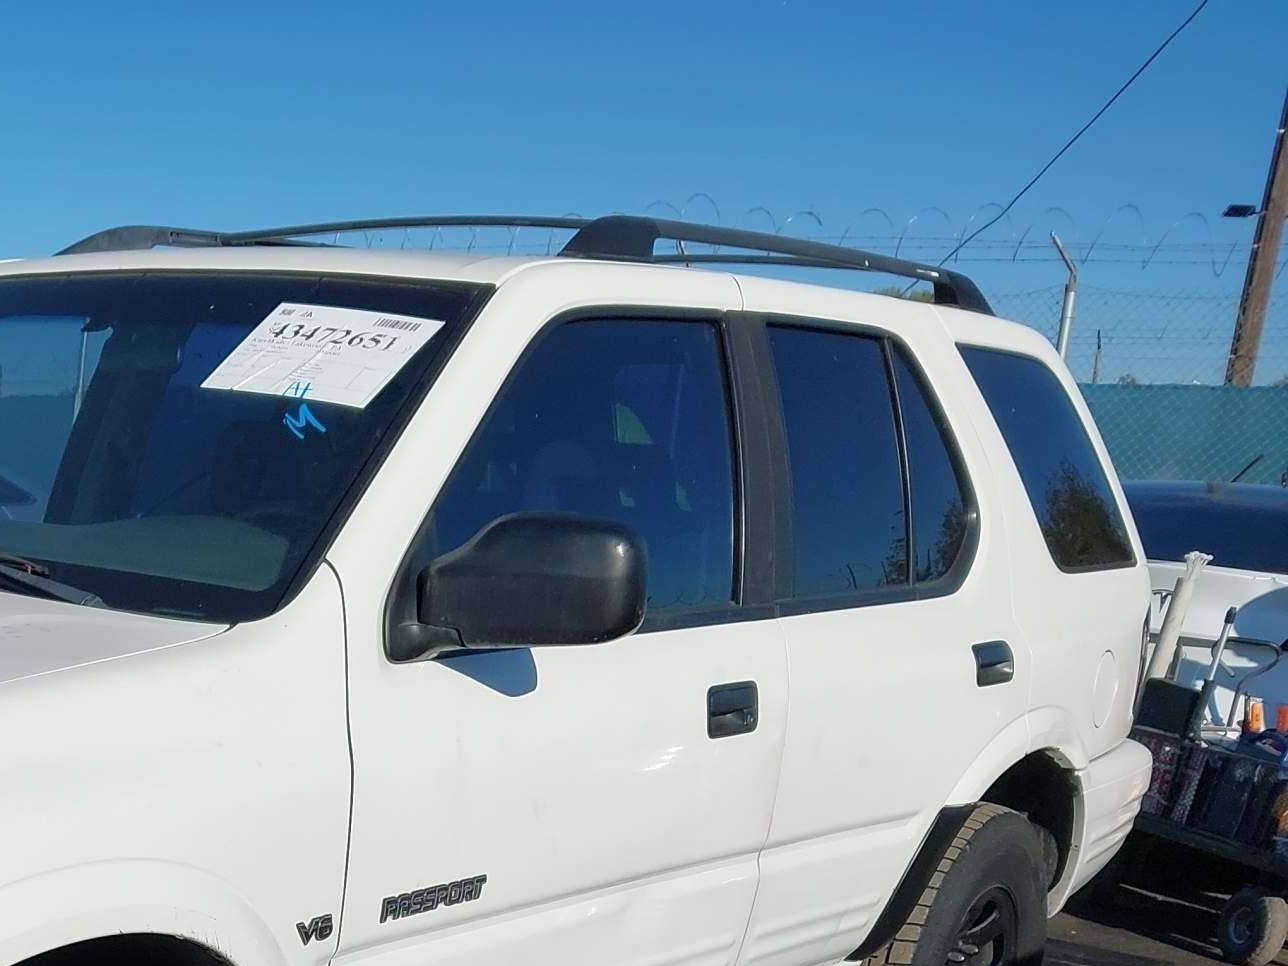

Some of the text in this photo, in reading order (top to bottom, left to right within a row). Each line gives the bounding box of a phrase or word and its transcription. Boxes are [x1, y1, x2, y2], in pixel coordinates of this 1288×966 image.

[272, 323, 398, 351] 43472651
[380, 874, 487, 923] PASSPORT
[296, 914, 333, 945] V6
